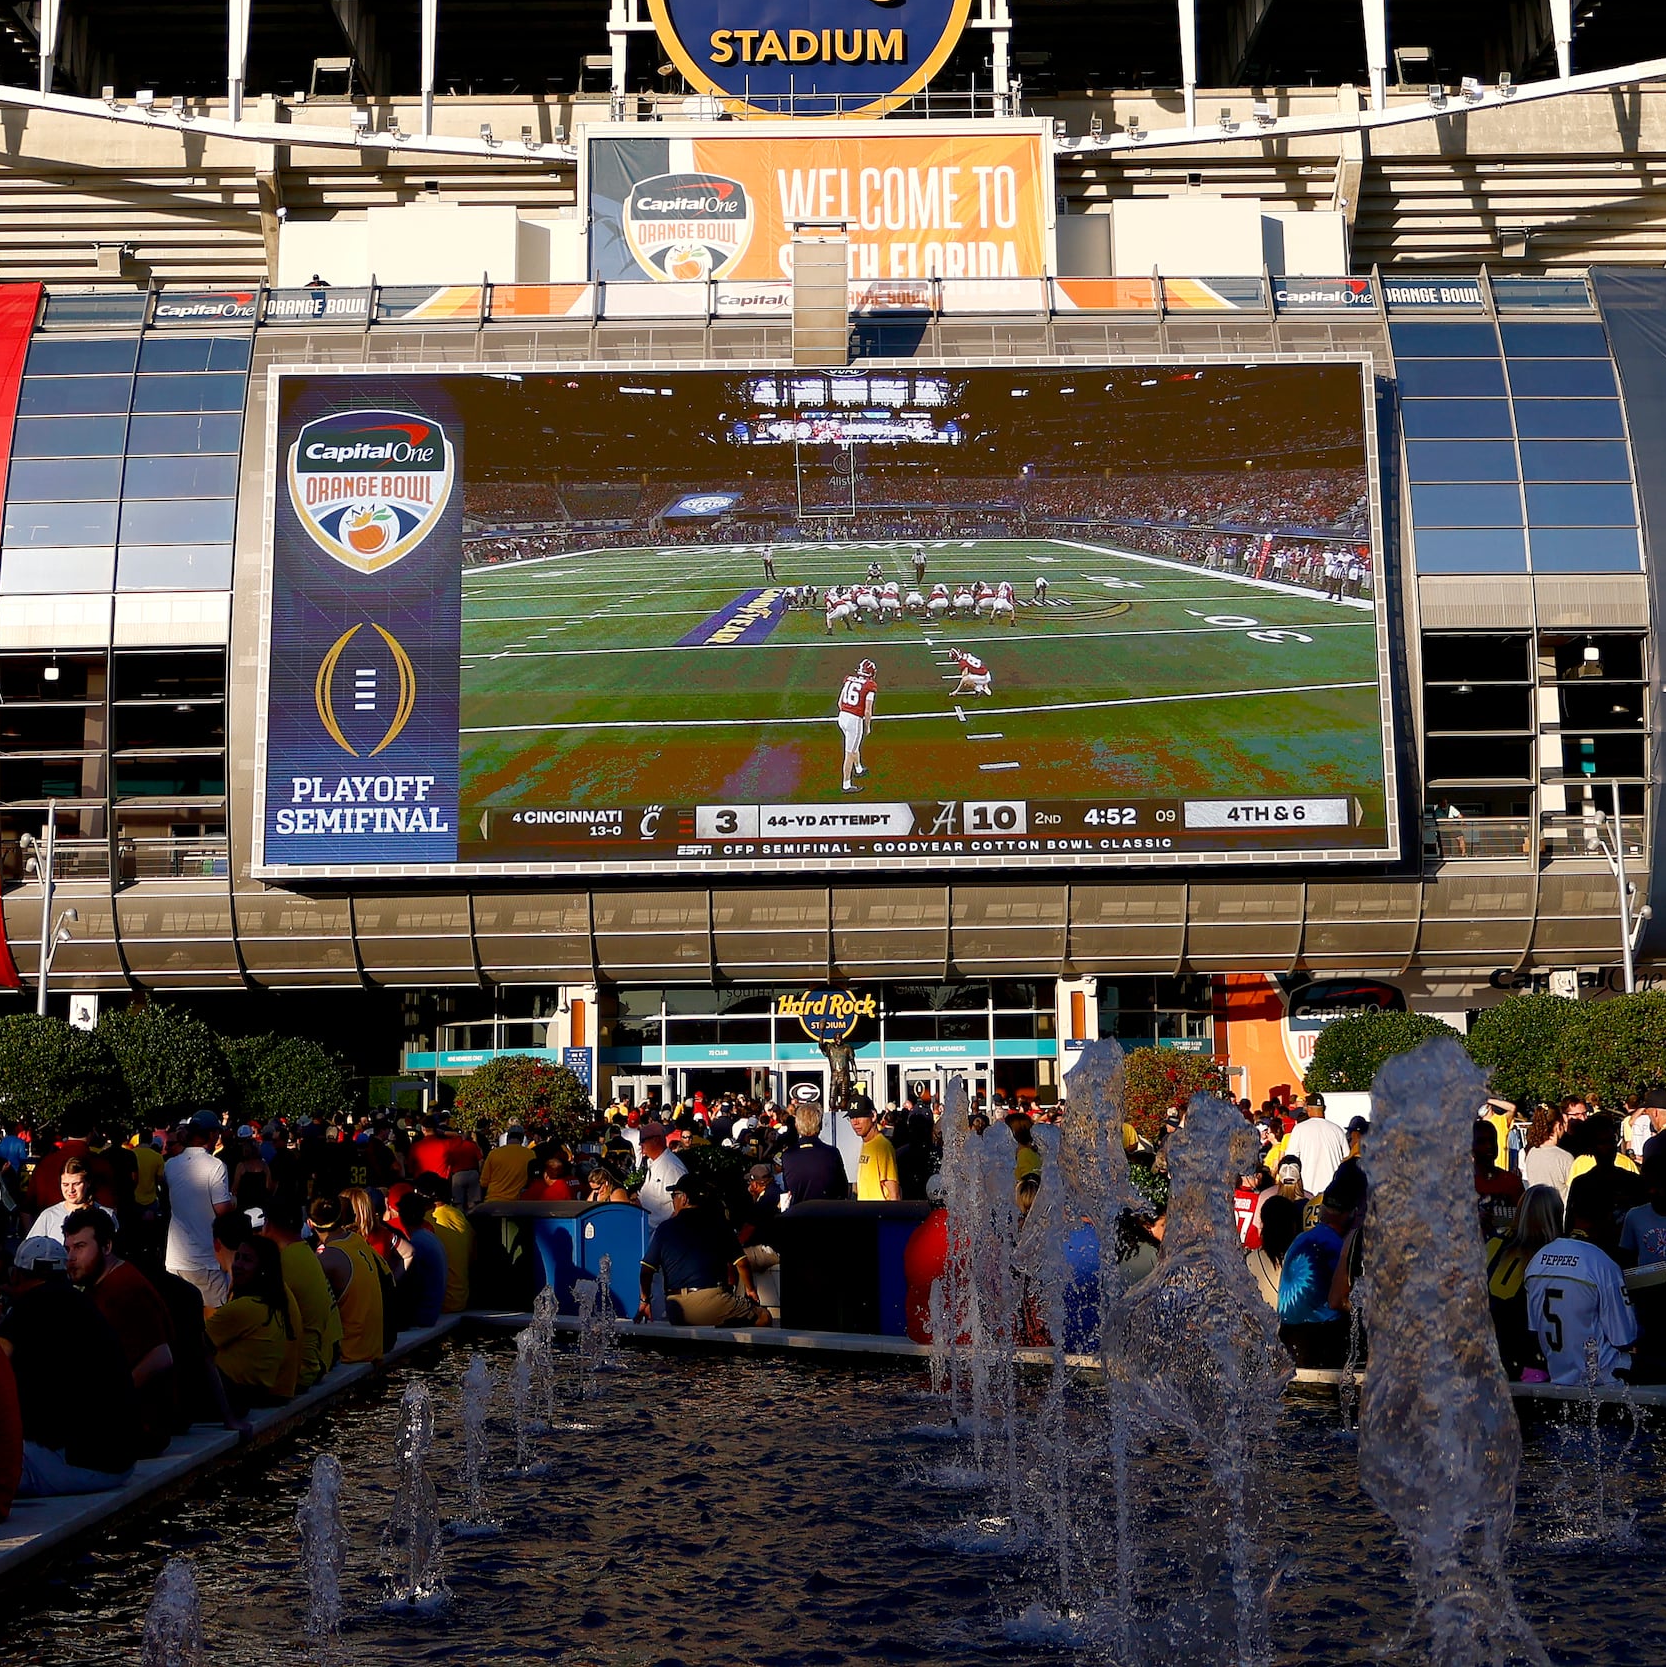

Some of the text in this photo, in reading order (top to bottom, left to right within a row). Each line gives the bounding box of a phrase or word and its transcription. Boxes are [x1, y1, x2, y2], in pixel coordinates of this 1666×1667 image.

[709, 28, 904, 63] STADIUM
[777, 165, 1017, 232] WELCOME TO
[638, 223, 738, 247] ORANGE BOWL
[890, 243, 1020, 282] FLORIDA
[1443, 286, 1483, 303] BOWL
[267, 299, 322, 316] ORANGE
[326, 298, 367, 315] BOWL
[306, 475, 434, 506] ORANGE BOWL
[828, 472, 865, 487] Allstate
[842, 681, 863, 706] 16
[291, 775, 435, 803] PLAYOFF
[275, 807, 449, 835] SEMIFINAL
[512, 809, 623, 824] 4 CINCINNATI
[715, 809, 739, 834] 3
[767, 813, 891, 829] 44-YD ATTEMPT
[971, 806, 1018, 831] 10
[1034, 807, 1176, 826] 2ND 4:52 09
[1226, 806, 1306, 822] 4TH & 6
[589, 825, 622, 837] 13-0
[677, 844, 712, 856] ESPN
[723, 845, 755, 855] CFP
[762, 842, 852, 855] SEMIFINAL
[873, 841, 964, 853] GOODYEAR
[971, 840, 1040, 852] COTTON
[1046, 839, 1095, 851] BOWL
[1099, 837, 1173, 850] CLASSIC
[777, 992, 876, 1019] Hard Rock
[810, 1021, 847, 1030] STDIUM
[350, 1165, 367, 1185] 32
[1540, 1253, 1580, 1268] PEPPERS
[1544, 1288, 1563, 1352] 5
